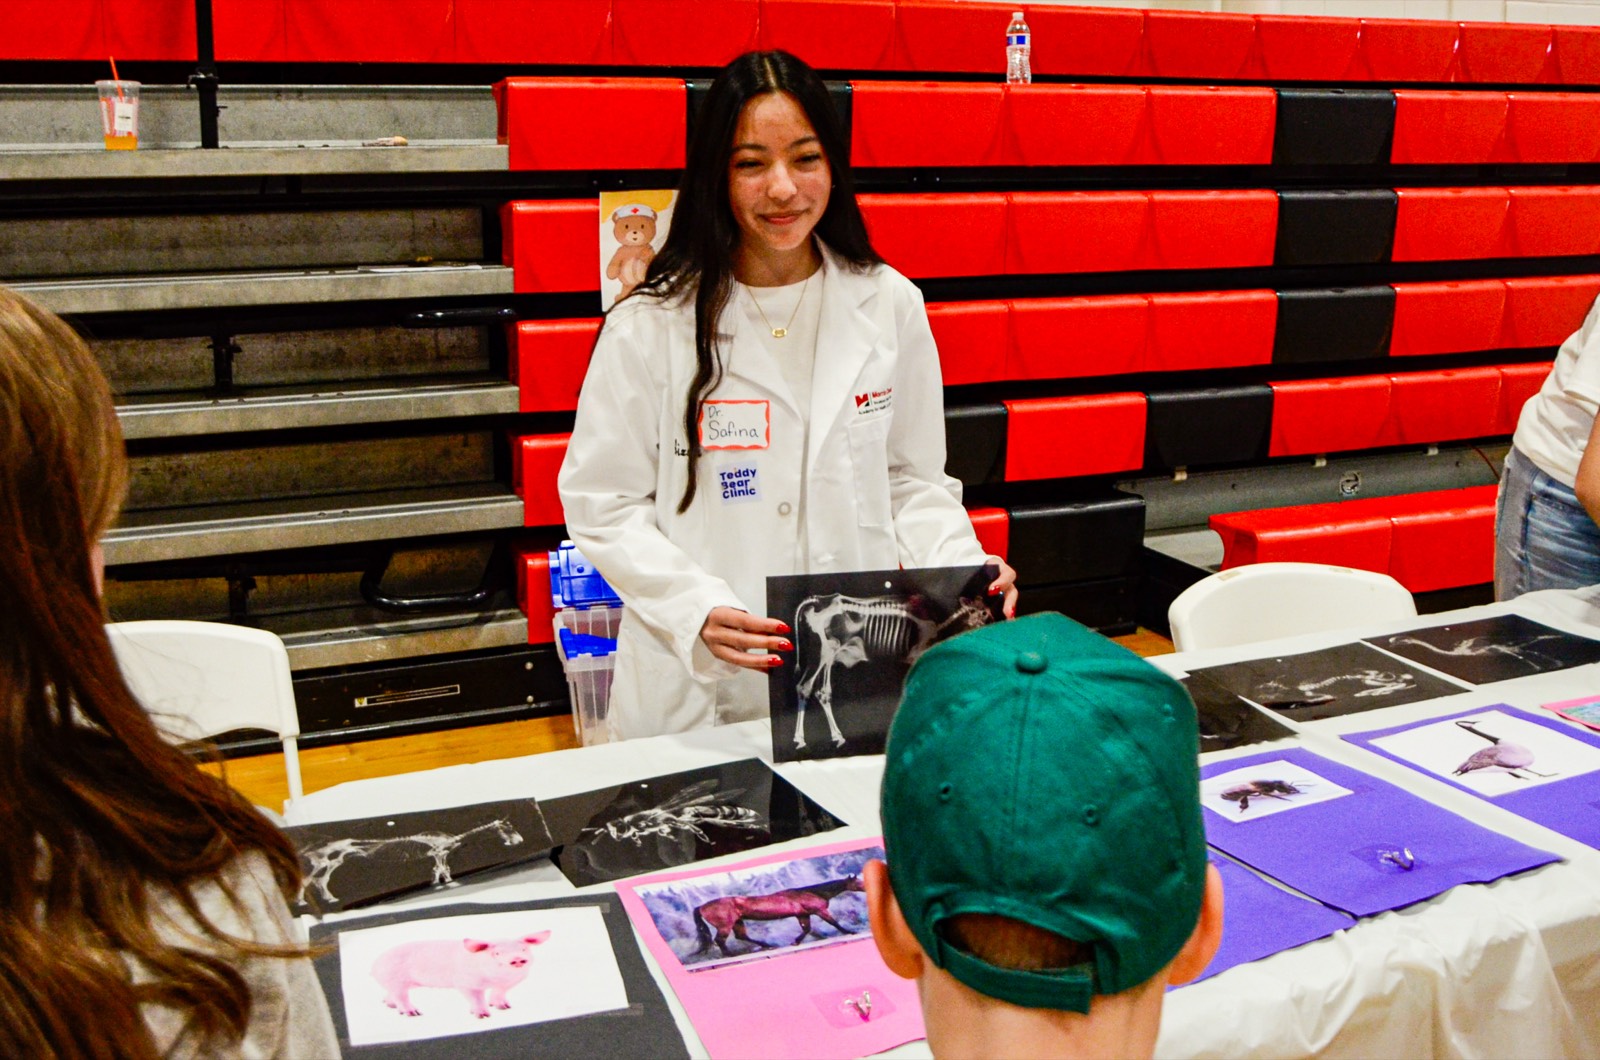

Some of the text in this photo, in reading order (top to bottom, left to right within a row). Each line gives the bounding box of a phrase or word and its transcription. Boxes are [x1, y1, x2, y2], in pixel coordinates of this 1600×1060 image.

[708, 420, 759, 441] Safina
[720, 468, 757, 481] Teddy
[720, 479, 751, 490] Bear
[722, 487, 757, 499] Clinic
